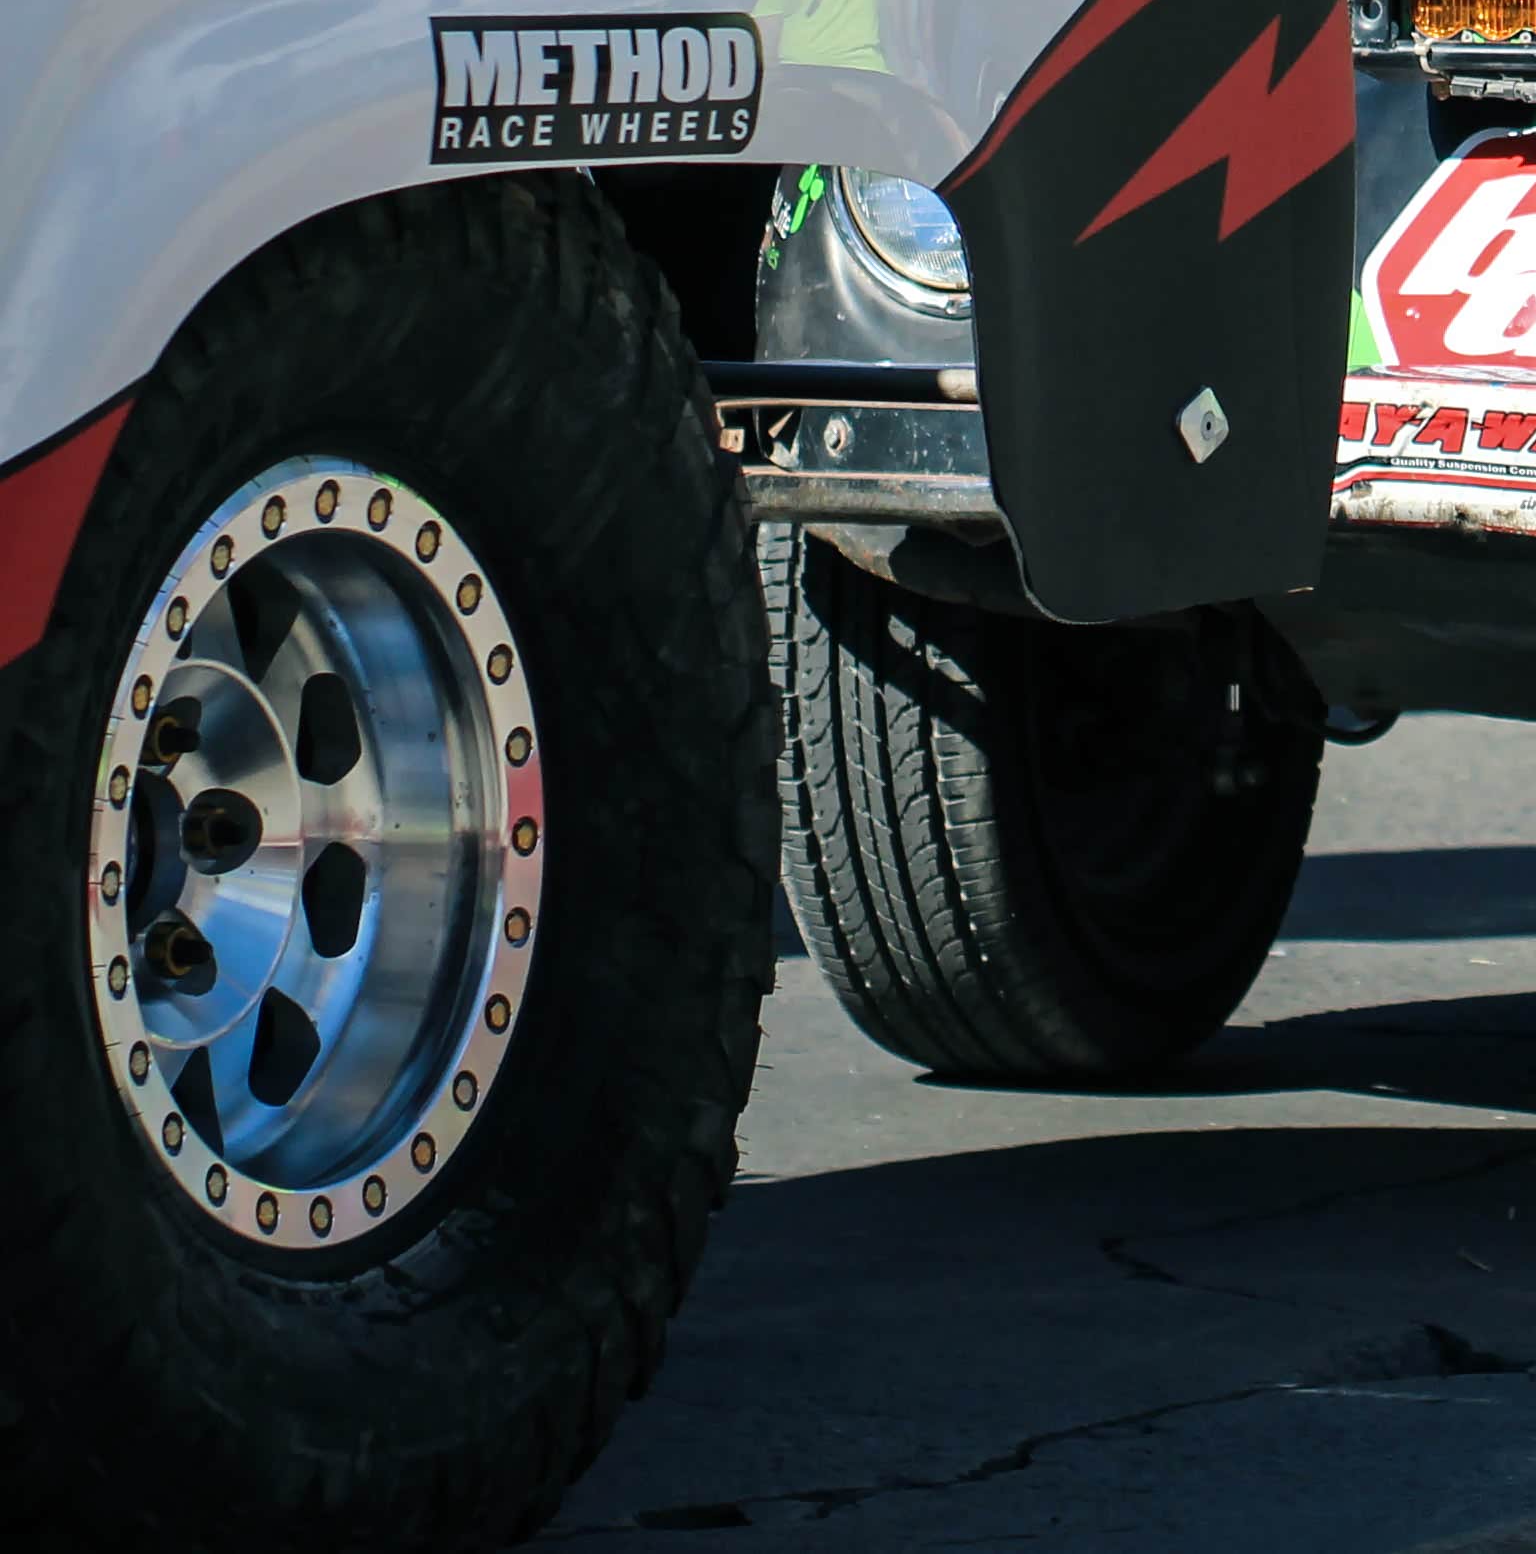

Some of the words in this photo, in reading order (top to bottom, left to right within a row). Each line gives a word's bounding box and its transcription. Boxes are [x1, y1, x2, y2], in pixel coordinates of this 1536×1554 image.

[440, 26, 757, 110] METHOD
[437, 115, 555, 150] RACE
[579, 107, 751, 148] WHEELS
[1390, 457, 1436, 469] Quality
[1438, 460, 1507, 475] Suspension
